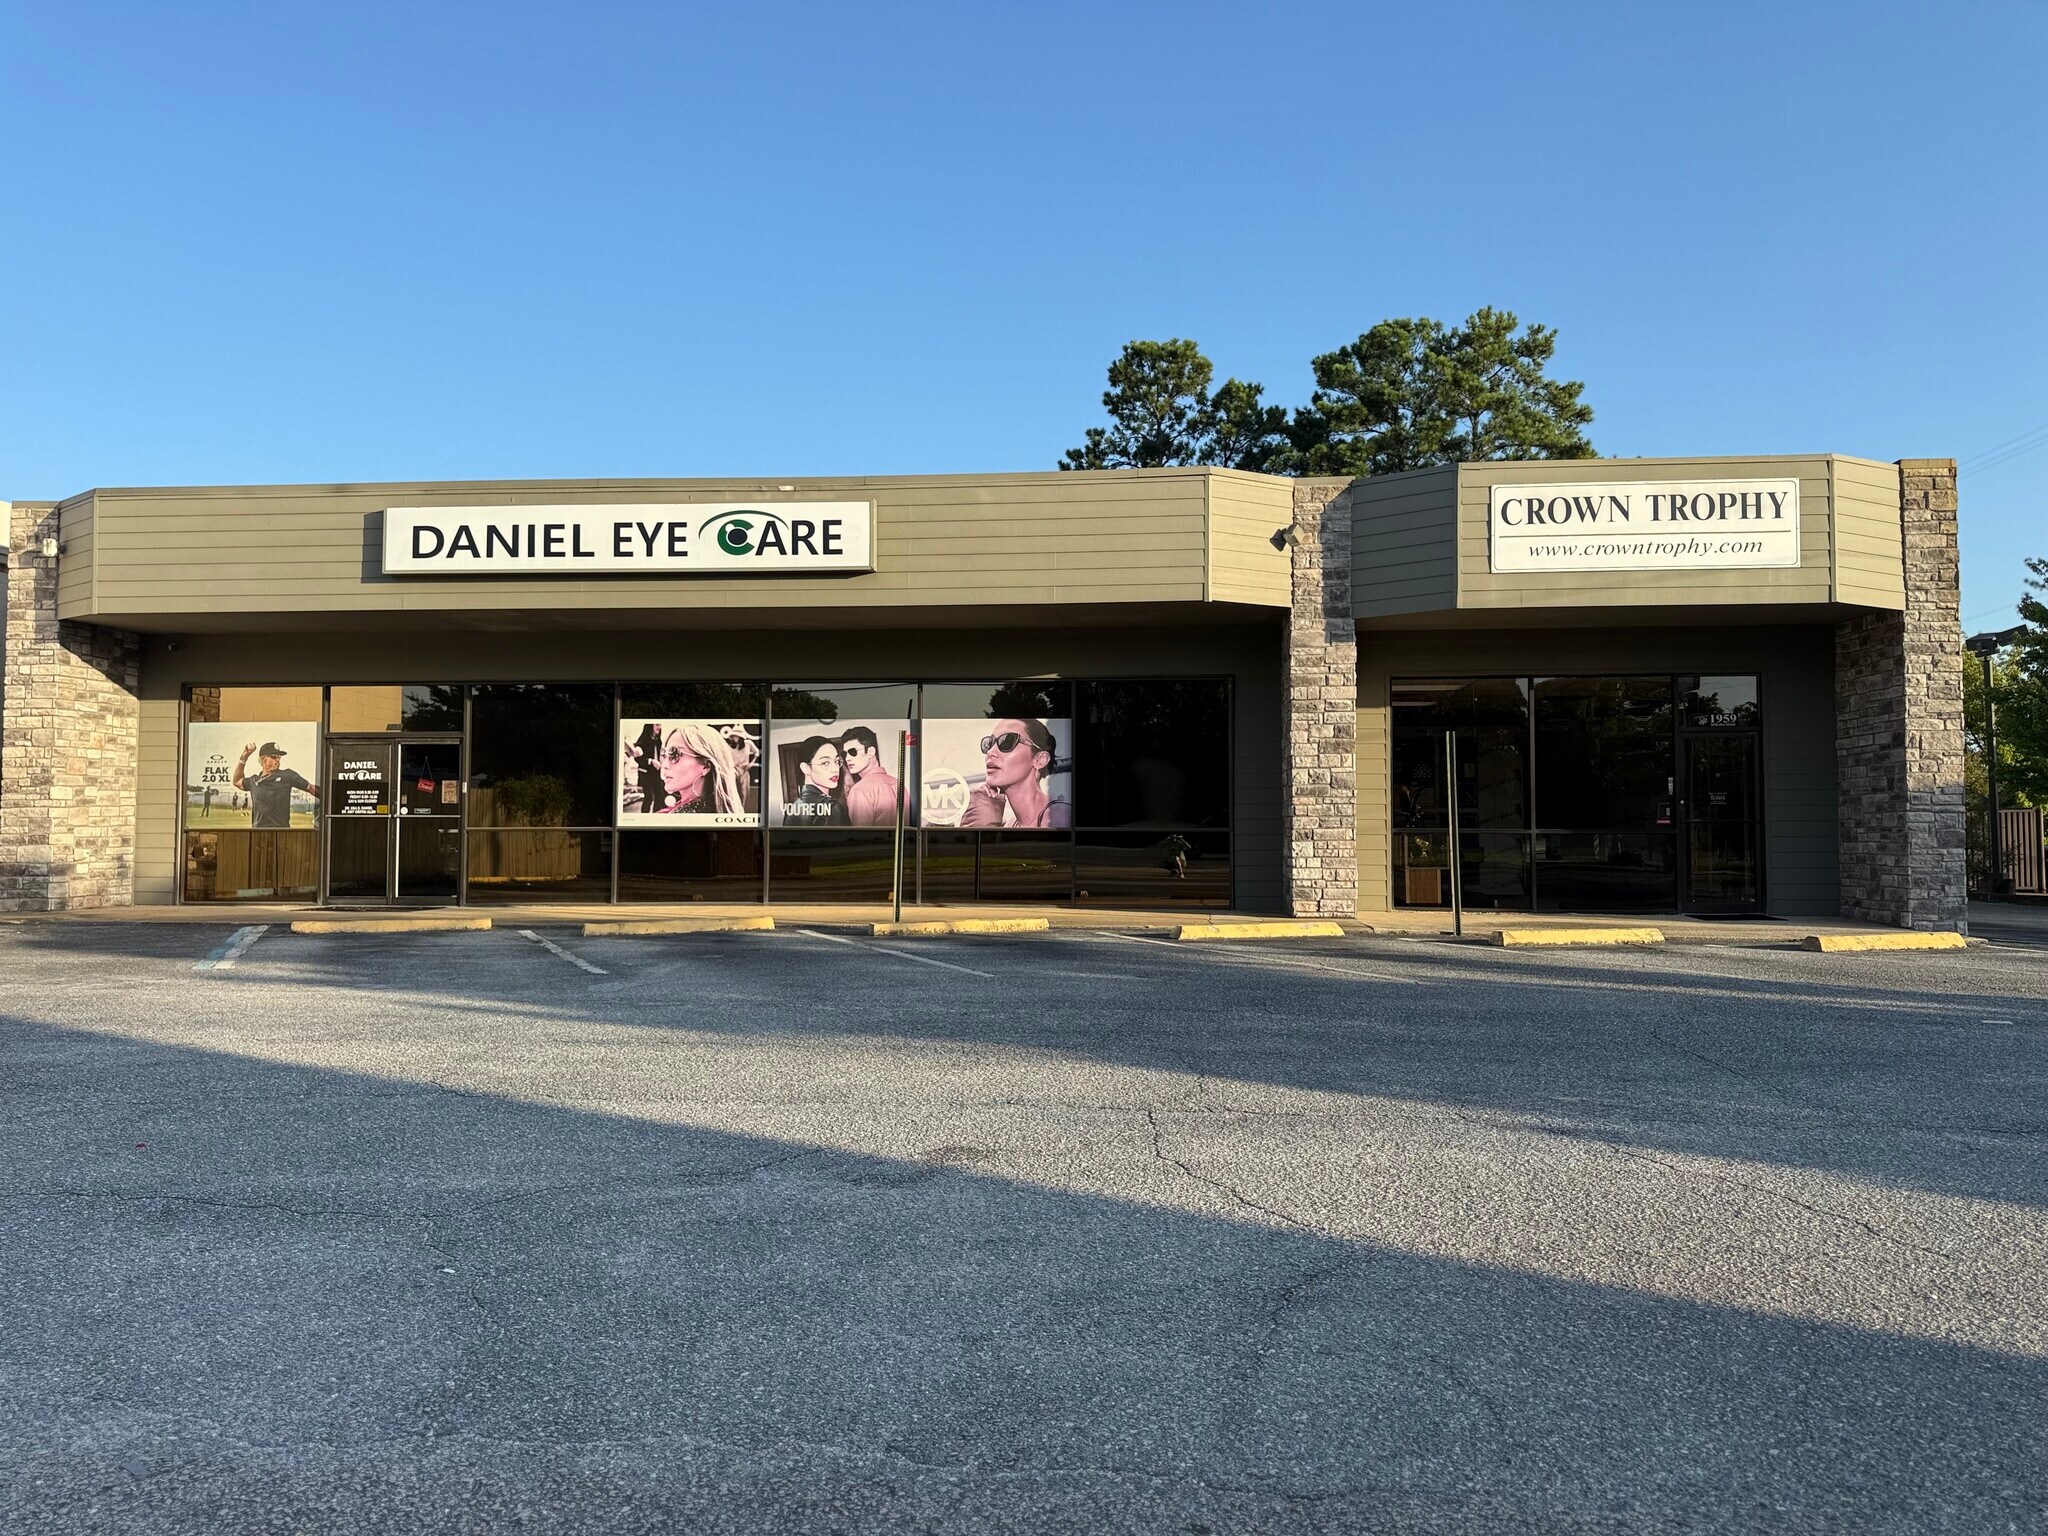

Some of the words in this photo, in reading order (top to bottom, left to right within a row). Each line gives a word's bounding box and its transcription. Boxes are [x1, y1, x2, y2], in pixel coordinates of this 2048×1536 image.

[1501, 494, 1632, 526] CROWN
[1645, 491, 1789, 522] TROPHY
[411, 523, 595, 559] DANIEL
[613, 521, 688, 558] EYE
[717, 518, 843, 556] CARE
[1529, 537, 1763, 558] www.crowntrophy.com
[1710, 714, 1737, 723] 1959
[204, 766, 229, 775] FLAK
[344, 761, 378, 770] DANIEL
[202, 775, 217, 783] 2.0
[218, 775, 231, 783] XL
[338, 772, 355, 780] EYE
[357, 771, 382, 781] CARE
[921, 783, 962, 809] MK
[779, 802, 815, 816] YOU'RE
[817, 802, 831, 816] ON
[714, 816, 761, 824] COACH
